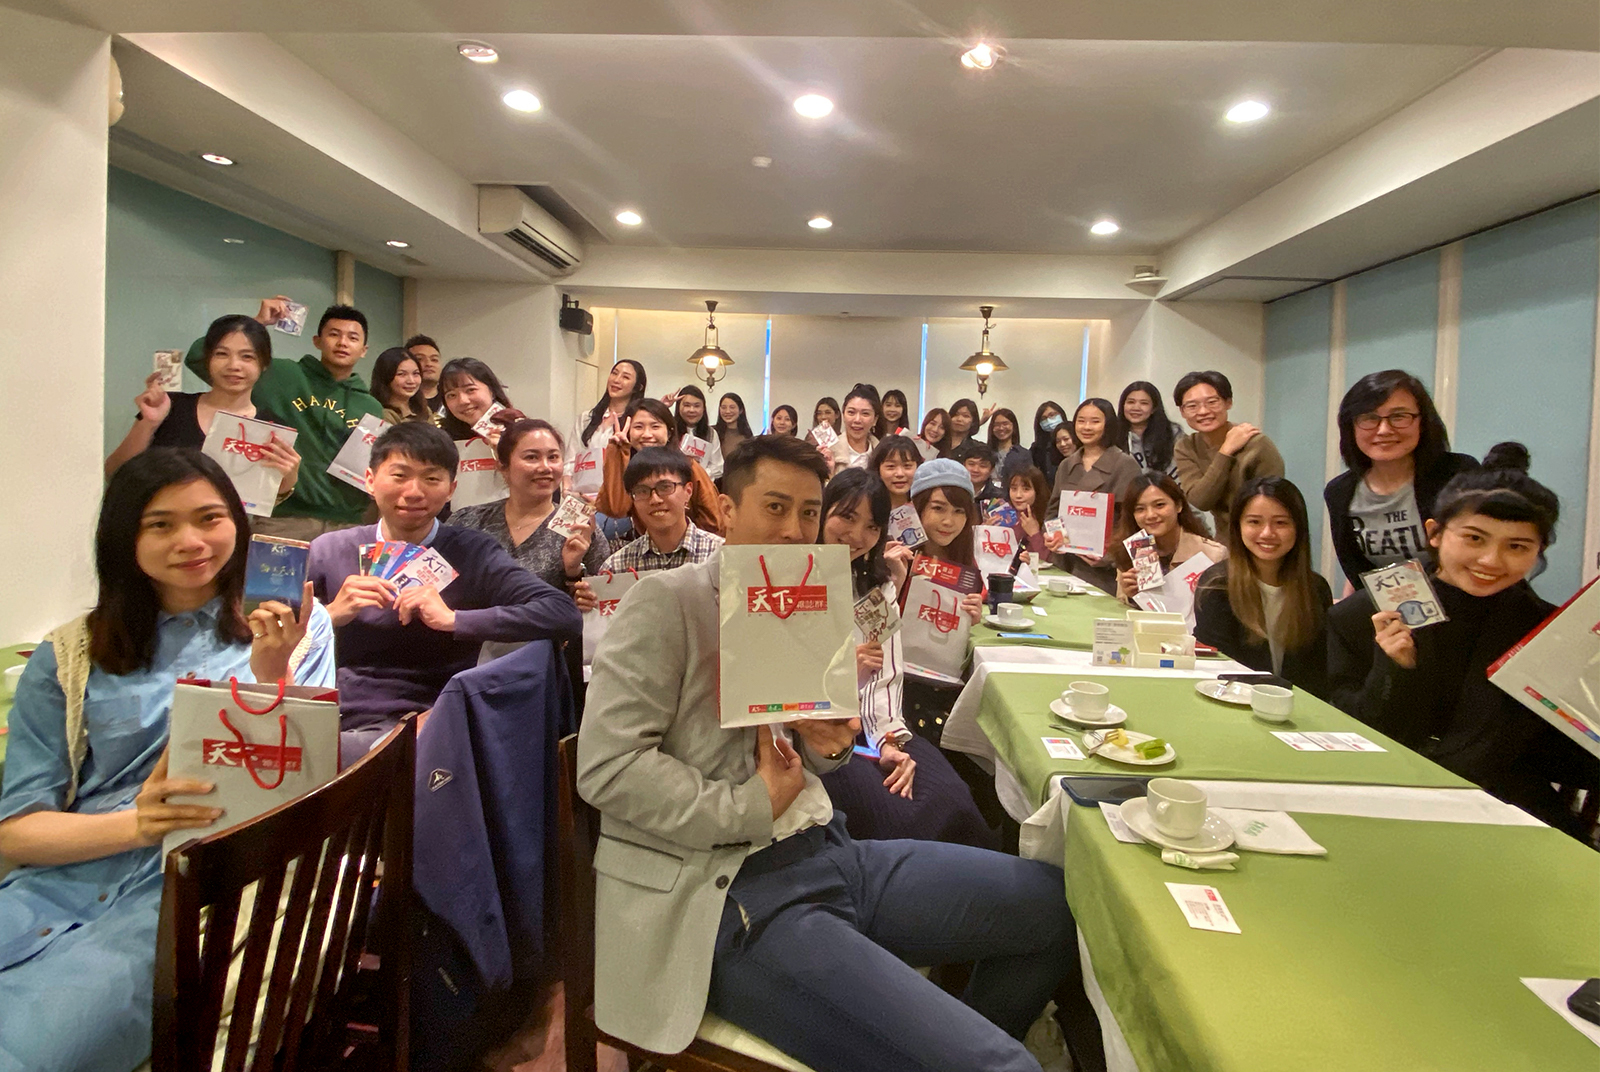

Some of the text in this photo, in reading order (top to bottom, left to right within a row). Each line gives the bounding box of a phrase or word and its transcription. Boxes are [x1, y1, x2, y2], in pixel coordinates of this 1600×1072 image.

[292, 395, 359, 428] HANAH
[1384, 509, 1408, 523] THE
[1348, 516, 1426, 560] BEATL
[422, 553, 447, 574] 天下
[917, 559, 941, 576] 天下
[1374, 571, 1405, 592] 天下
[751, 588, 793, 612] 天下
